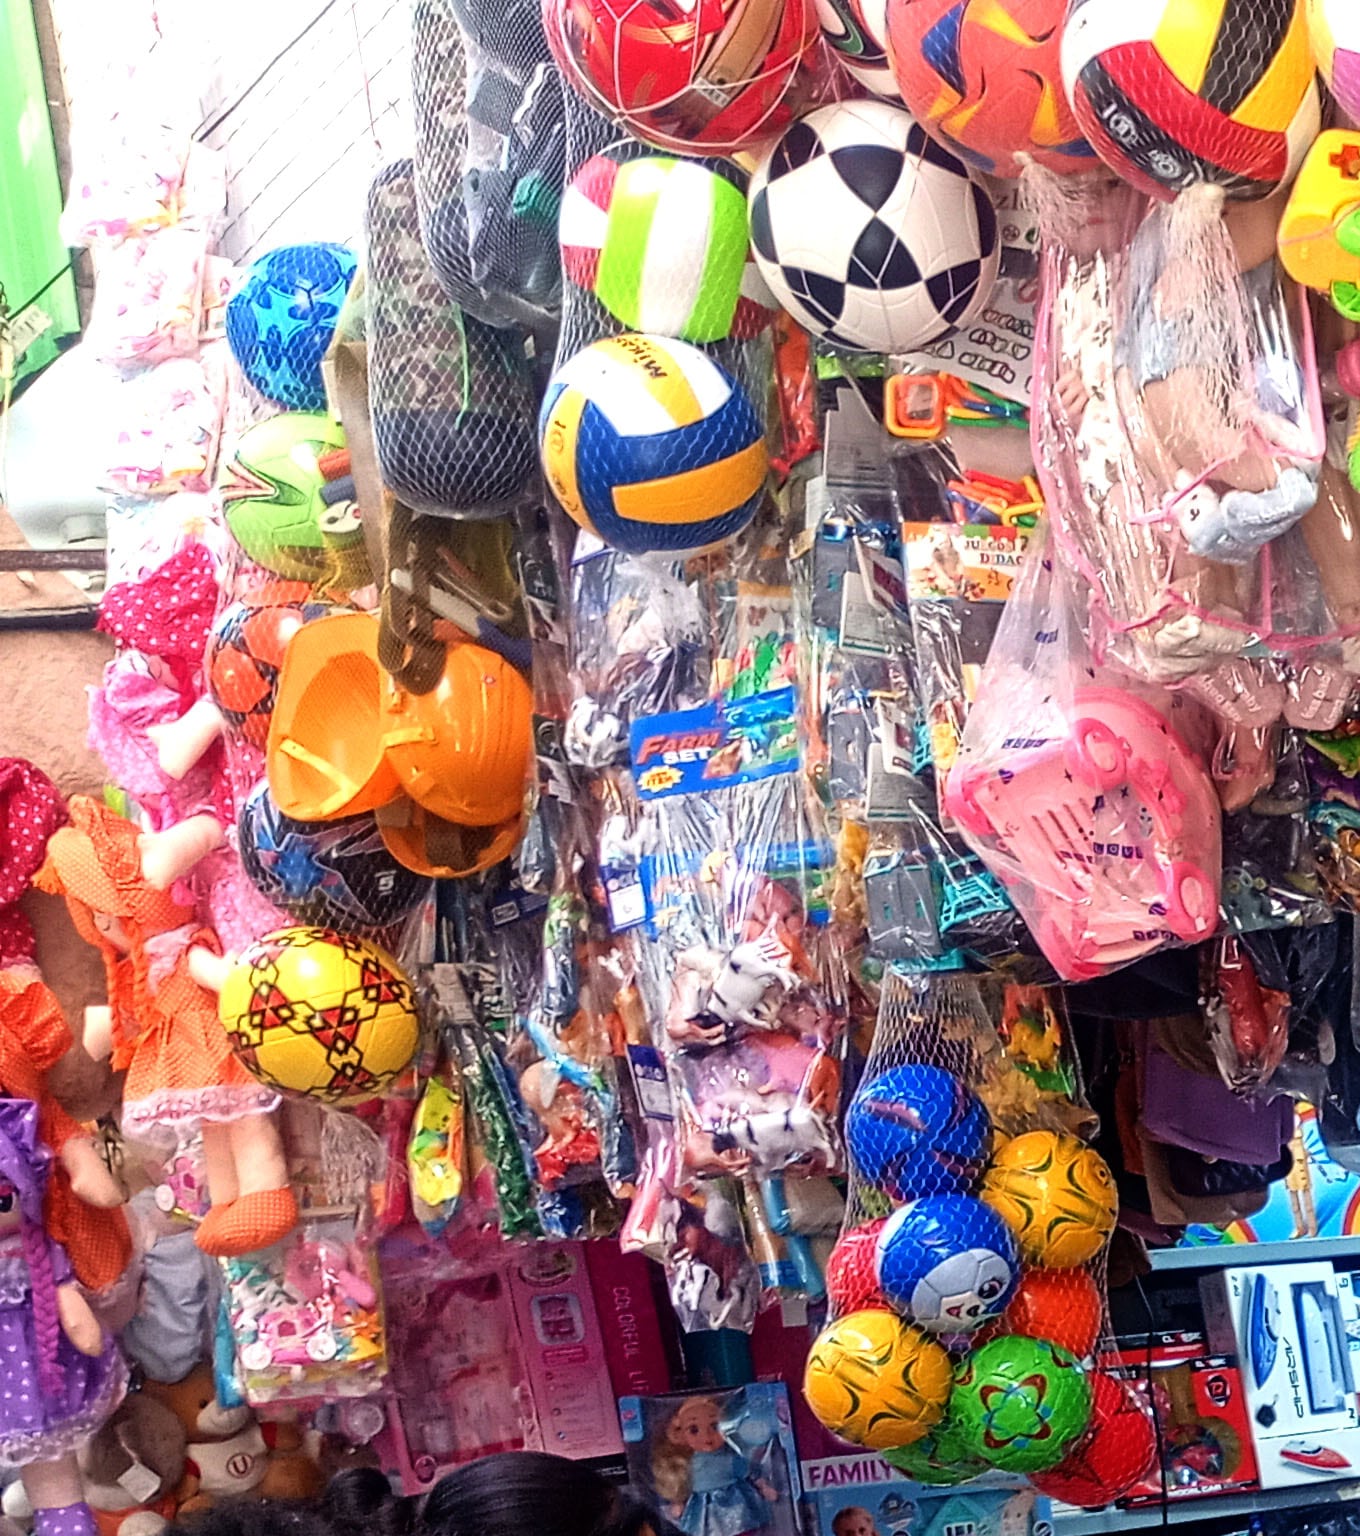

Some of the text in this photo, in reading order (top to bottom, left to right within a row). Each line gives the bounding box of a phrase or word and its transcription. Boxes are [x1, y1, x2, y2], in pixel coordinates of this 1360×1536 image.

[636, 728, 723, 765] FARM
[662, 746, 712, 765] SET
[808, 1459, 892, 1488] FAMILY
